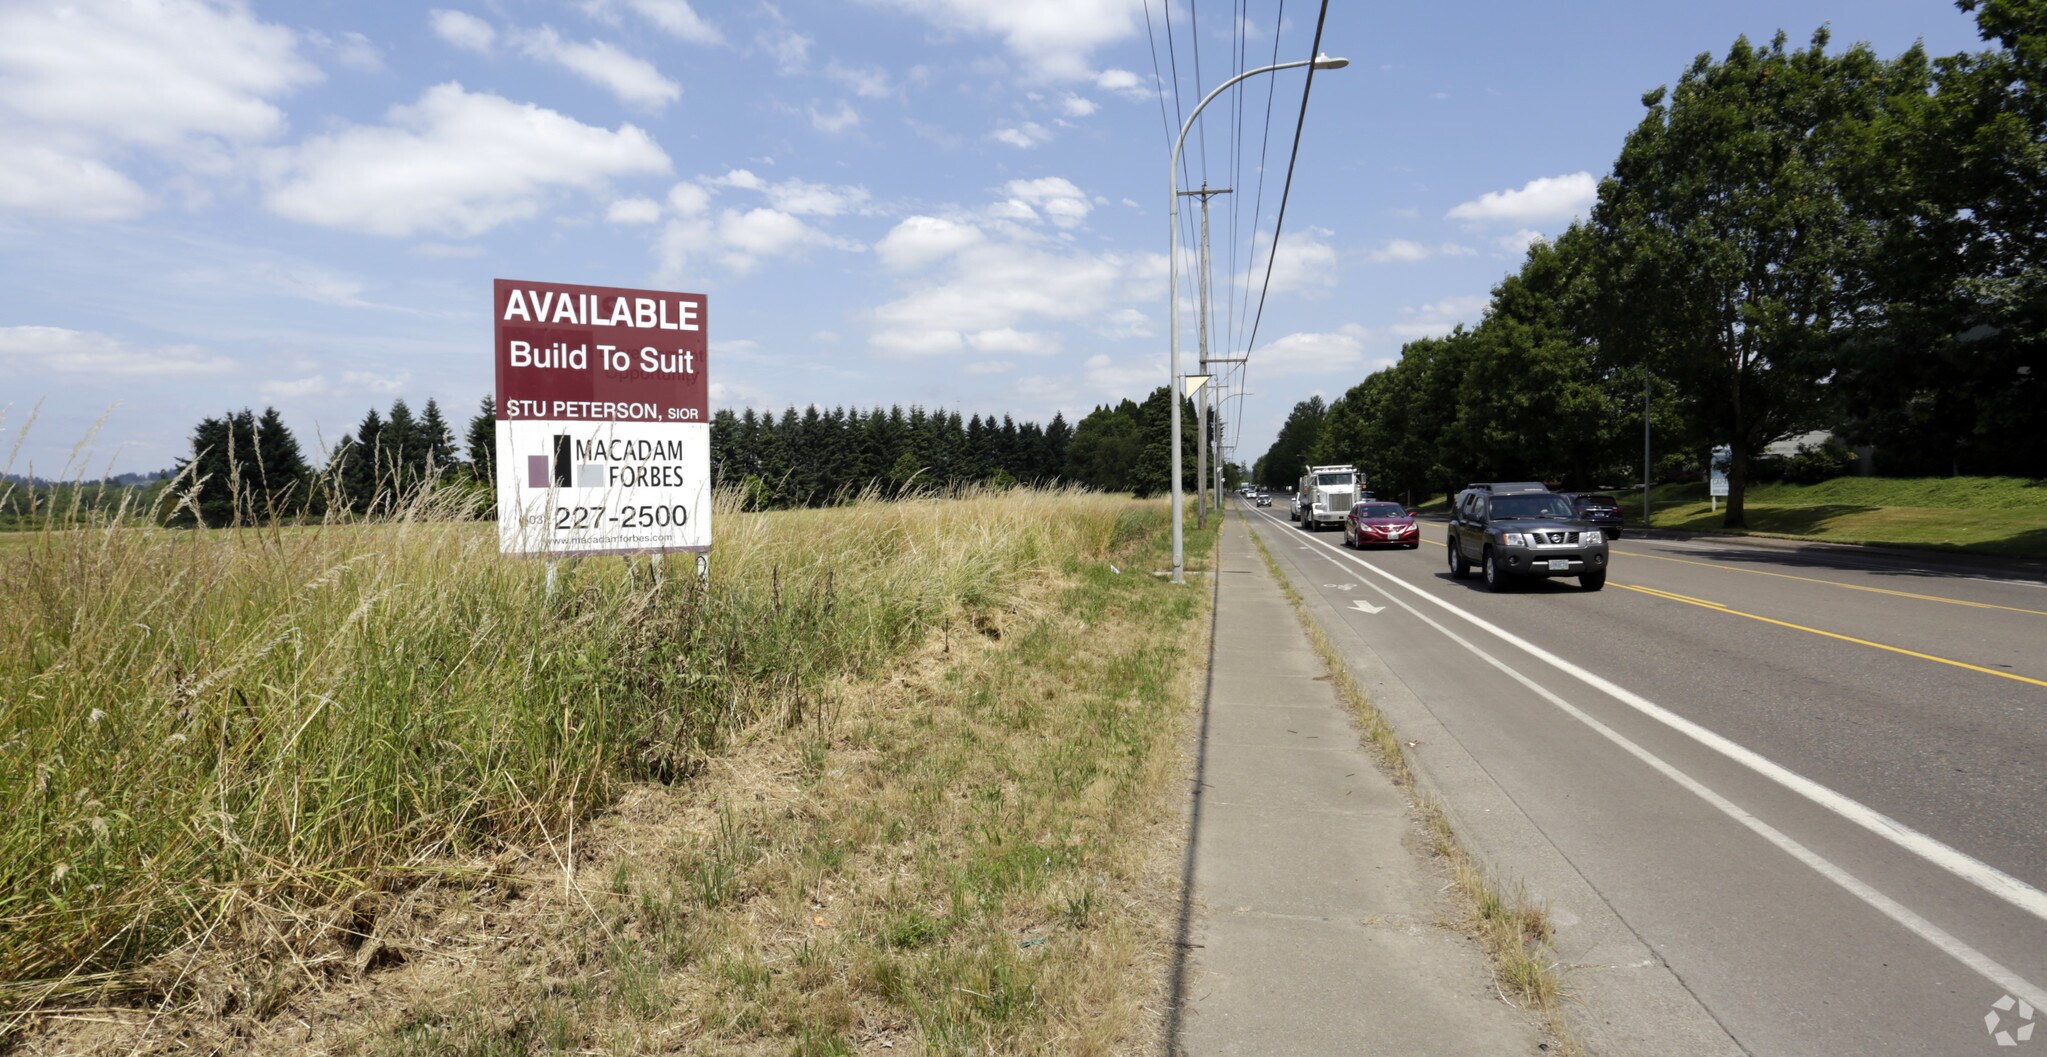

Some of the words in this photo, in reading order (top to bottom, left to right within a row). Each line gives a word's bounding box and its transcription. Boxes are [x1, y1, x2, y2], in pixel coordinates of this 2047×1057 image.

[503, 289, 699, 331] AVAILABLE
[510, 340, 587, 370] Build
[596, 345, 631, 372] To
[640, 346, 694, 374] Suit
[506, 400, 547, 417] STU
[553, 401, 663, 422] PETERSON,
[668, 408, 699, 420] SIOR
[576, 439, 683, 461] MACADAM
[609, 466, 684, 488] FORBES
[555, 504, 688, 530] 227-2500
[548, 534, 673, 546] ww.macadamforbes.com
